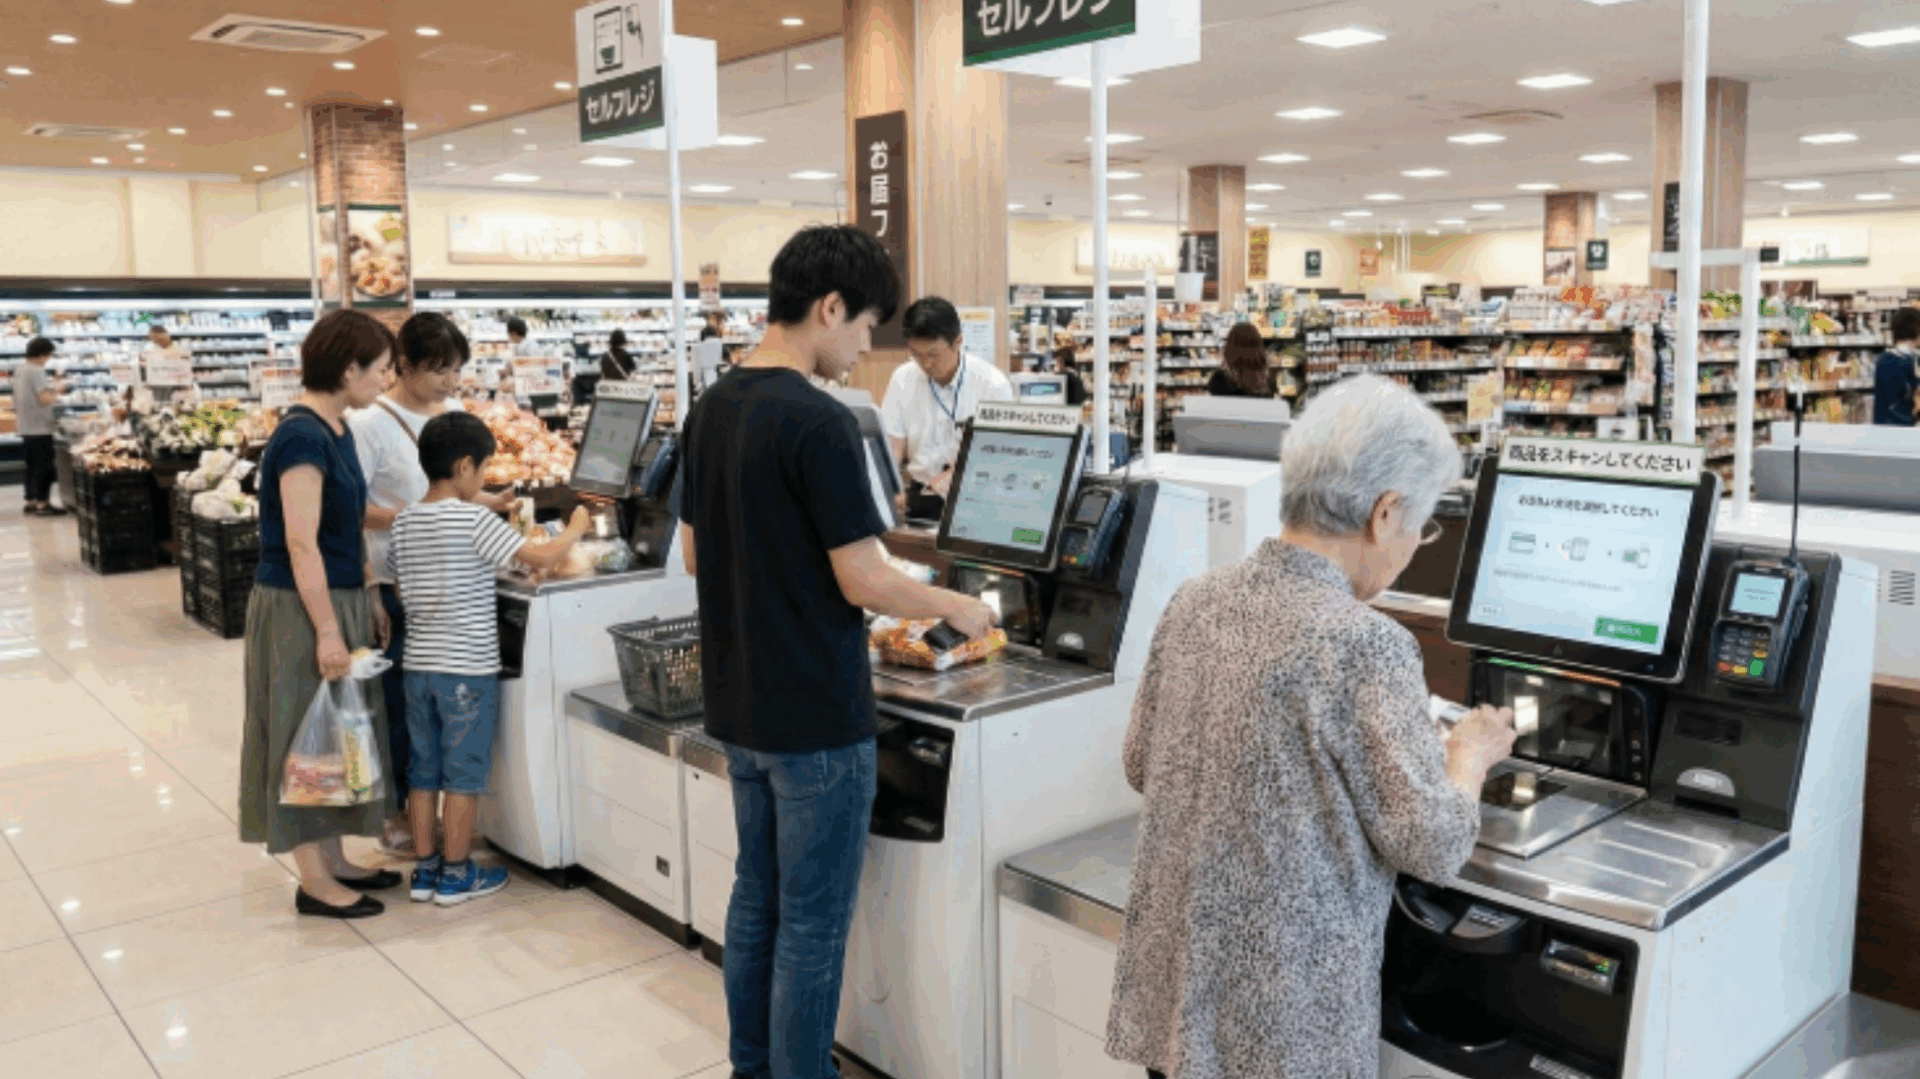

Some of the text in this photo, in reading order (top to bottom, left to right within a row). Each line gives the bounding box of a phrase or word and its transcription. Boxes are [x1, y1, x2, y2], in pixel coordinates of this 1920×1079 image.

[586, 79, 655, 125] セルフレジ
[1509, 444, 1692, 473] 商品をスキャンしてください
